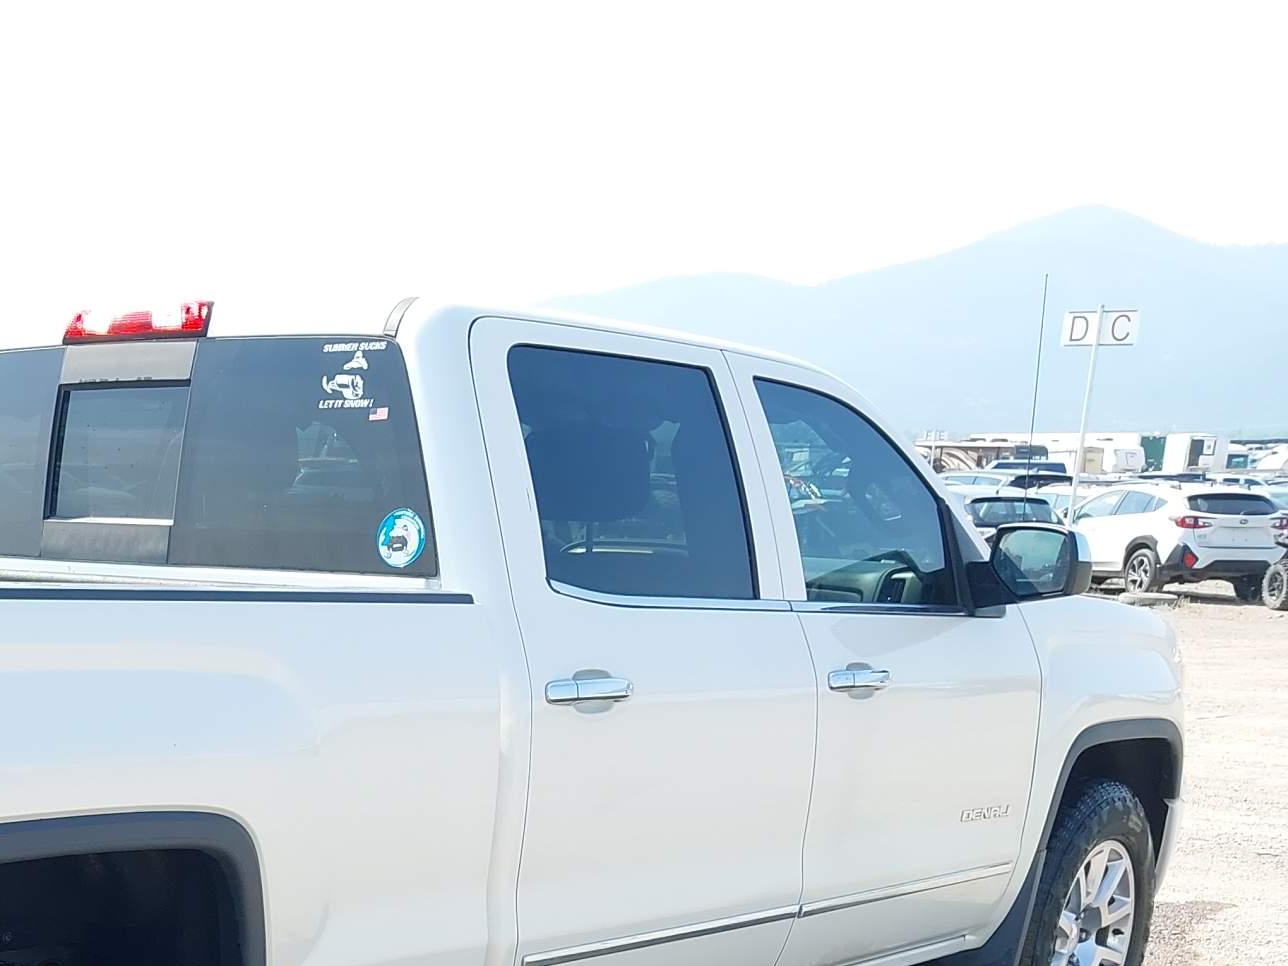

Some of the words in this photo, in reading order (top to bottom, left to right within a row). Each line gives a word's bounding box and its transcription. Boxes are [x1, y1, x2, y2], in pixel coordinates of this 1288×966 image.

[1069, 315, 1089, 342] D
[1111, 314, 1131, 342] C
[359, 341, 387, 350] SUCKS
[960, 804, 1010, 822] DENALI
